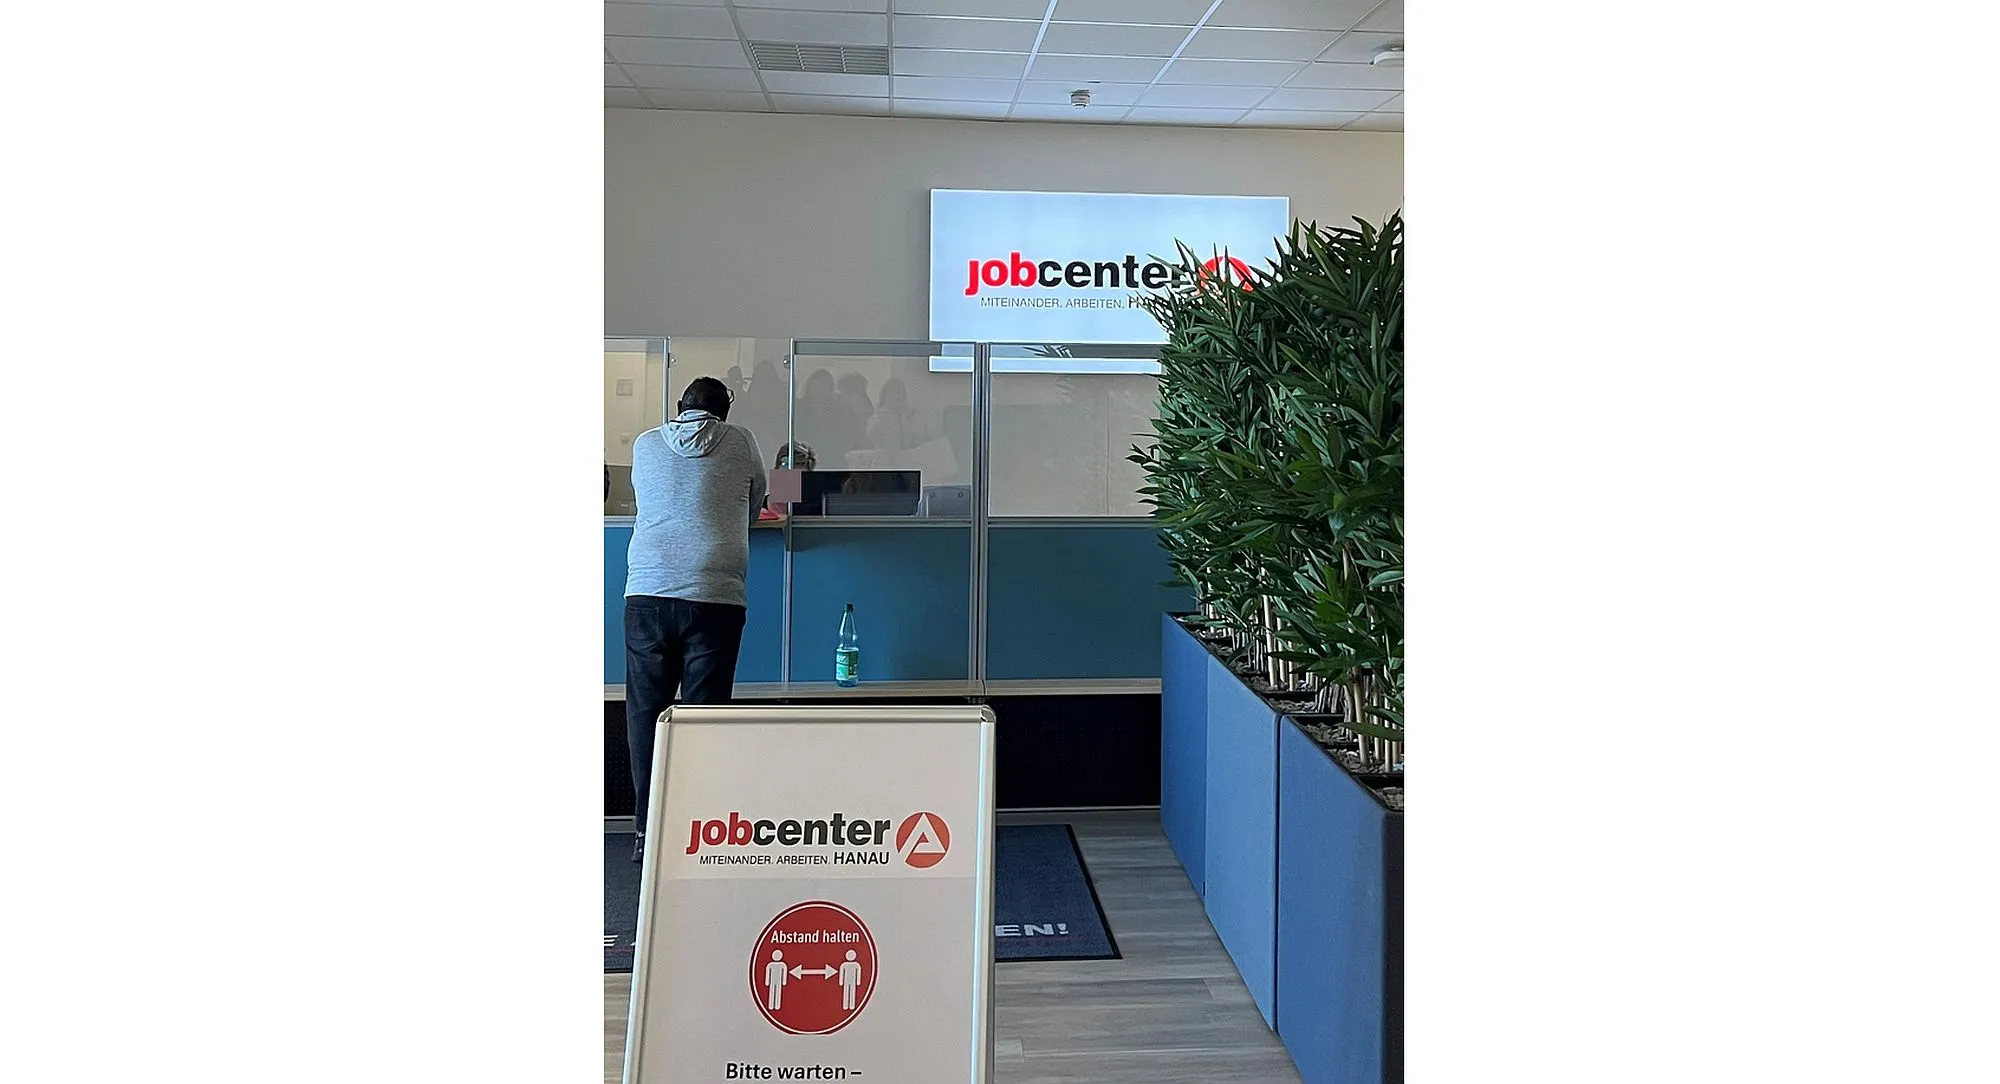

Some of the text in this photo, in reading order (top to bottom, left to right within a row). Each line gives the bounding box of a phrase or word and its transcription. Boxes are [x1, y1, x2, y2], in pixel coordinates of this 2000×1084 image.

[980, 297, 1062, 309] MITEINANDER.
[1065, 298, 1125, 309] ARBEITEN.
[686, 811, 891, 855] jobcenter
[699, 851, 890, 865] MITEINANDER. ARBEITEN. HANAU
[770, 929, 860, 944] Abstand halten
[726, 1062, 772, 1079] Bitte
[777, 1064, 846, 1079] warten
